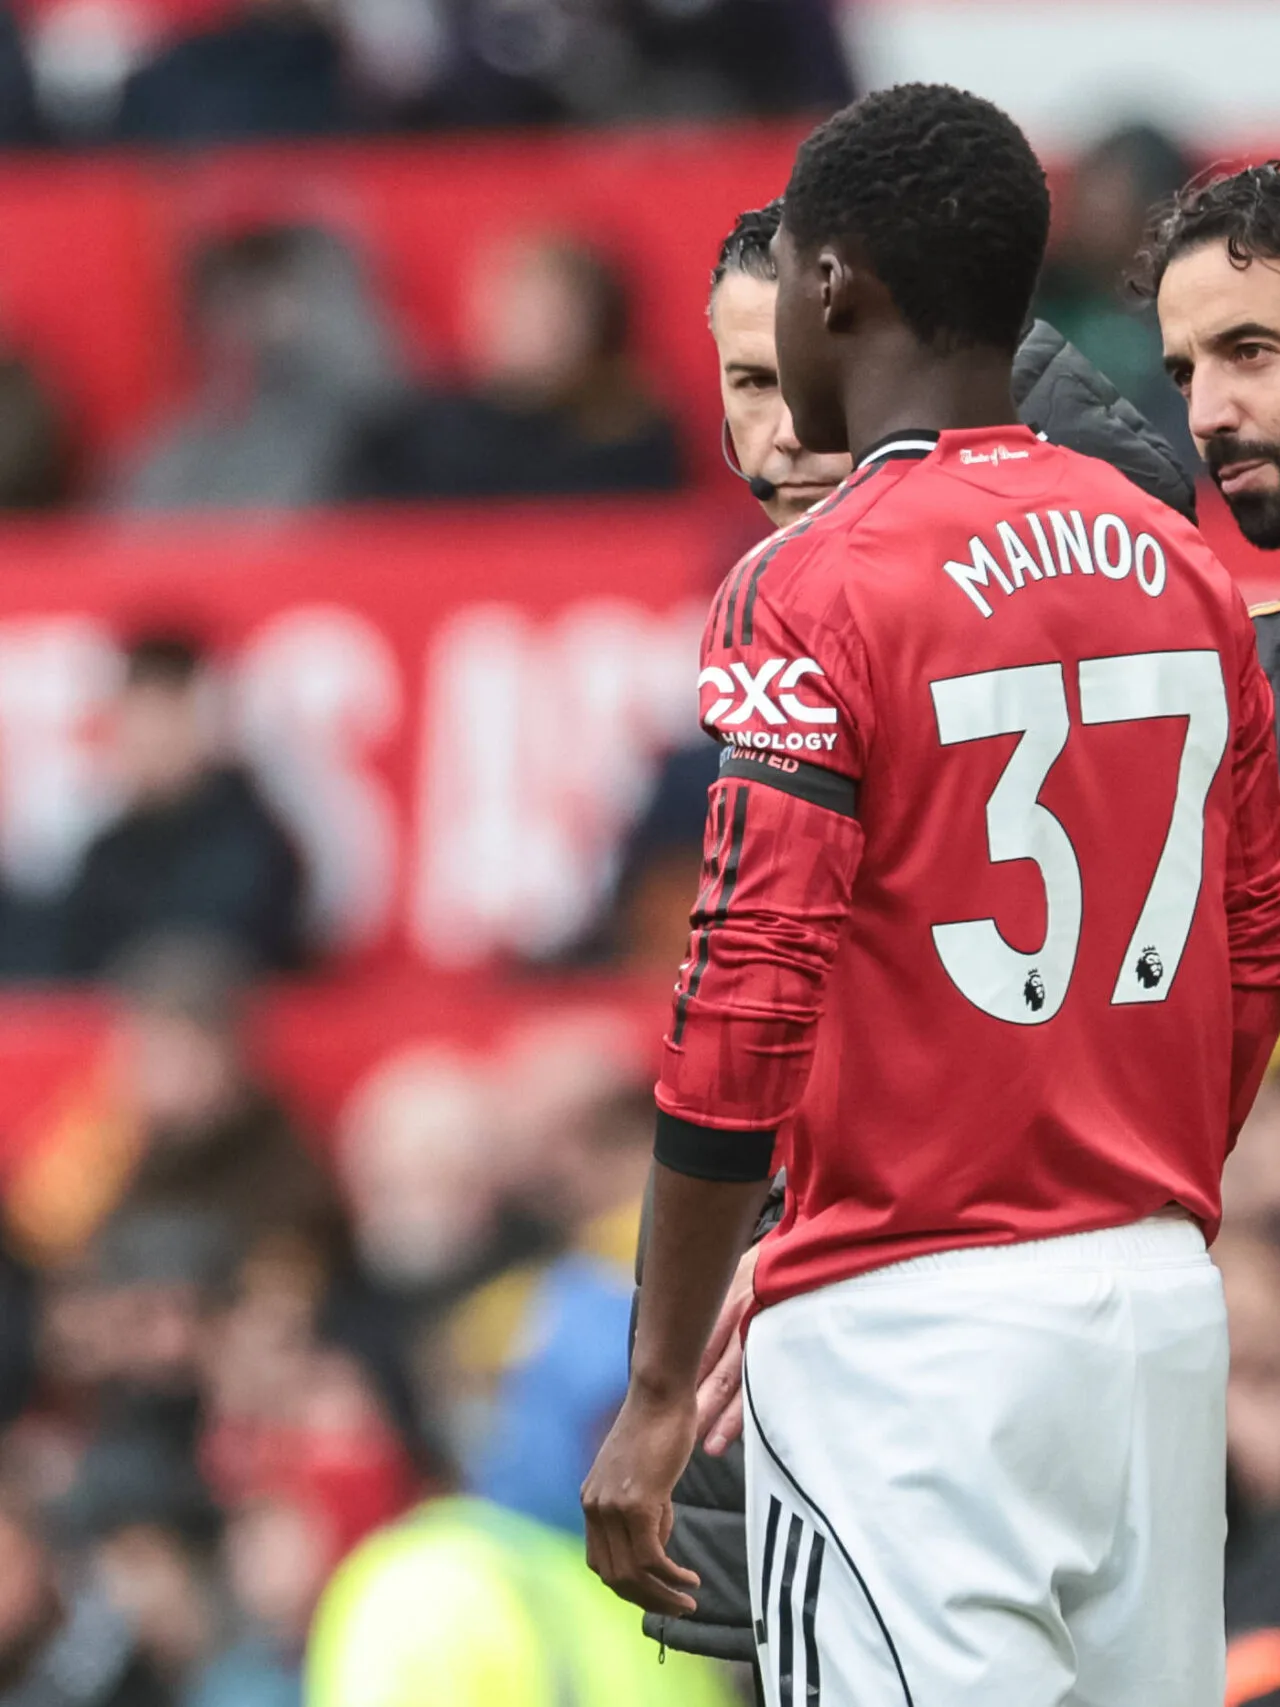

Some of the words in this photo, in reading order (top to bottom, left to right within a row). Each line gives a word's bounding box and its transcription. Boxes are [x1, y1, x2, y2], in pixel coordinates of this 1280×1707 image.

[943, 509, 1167, 618] MAINOO
[721, 730, 837, 750] HNOLOGY
[731, 748, 799, 773] UNITED
[929, 649, 1230, 1026] 37
